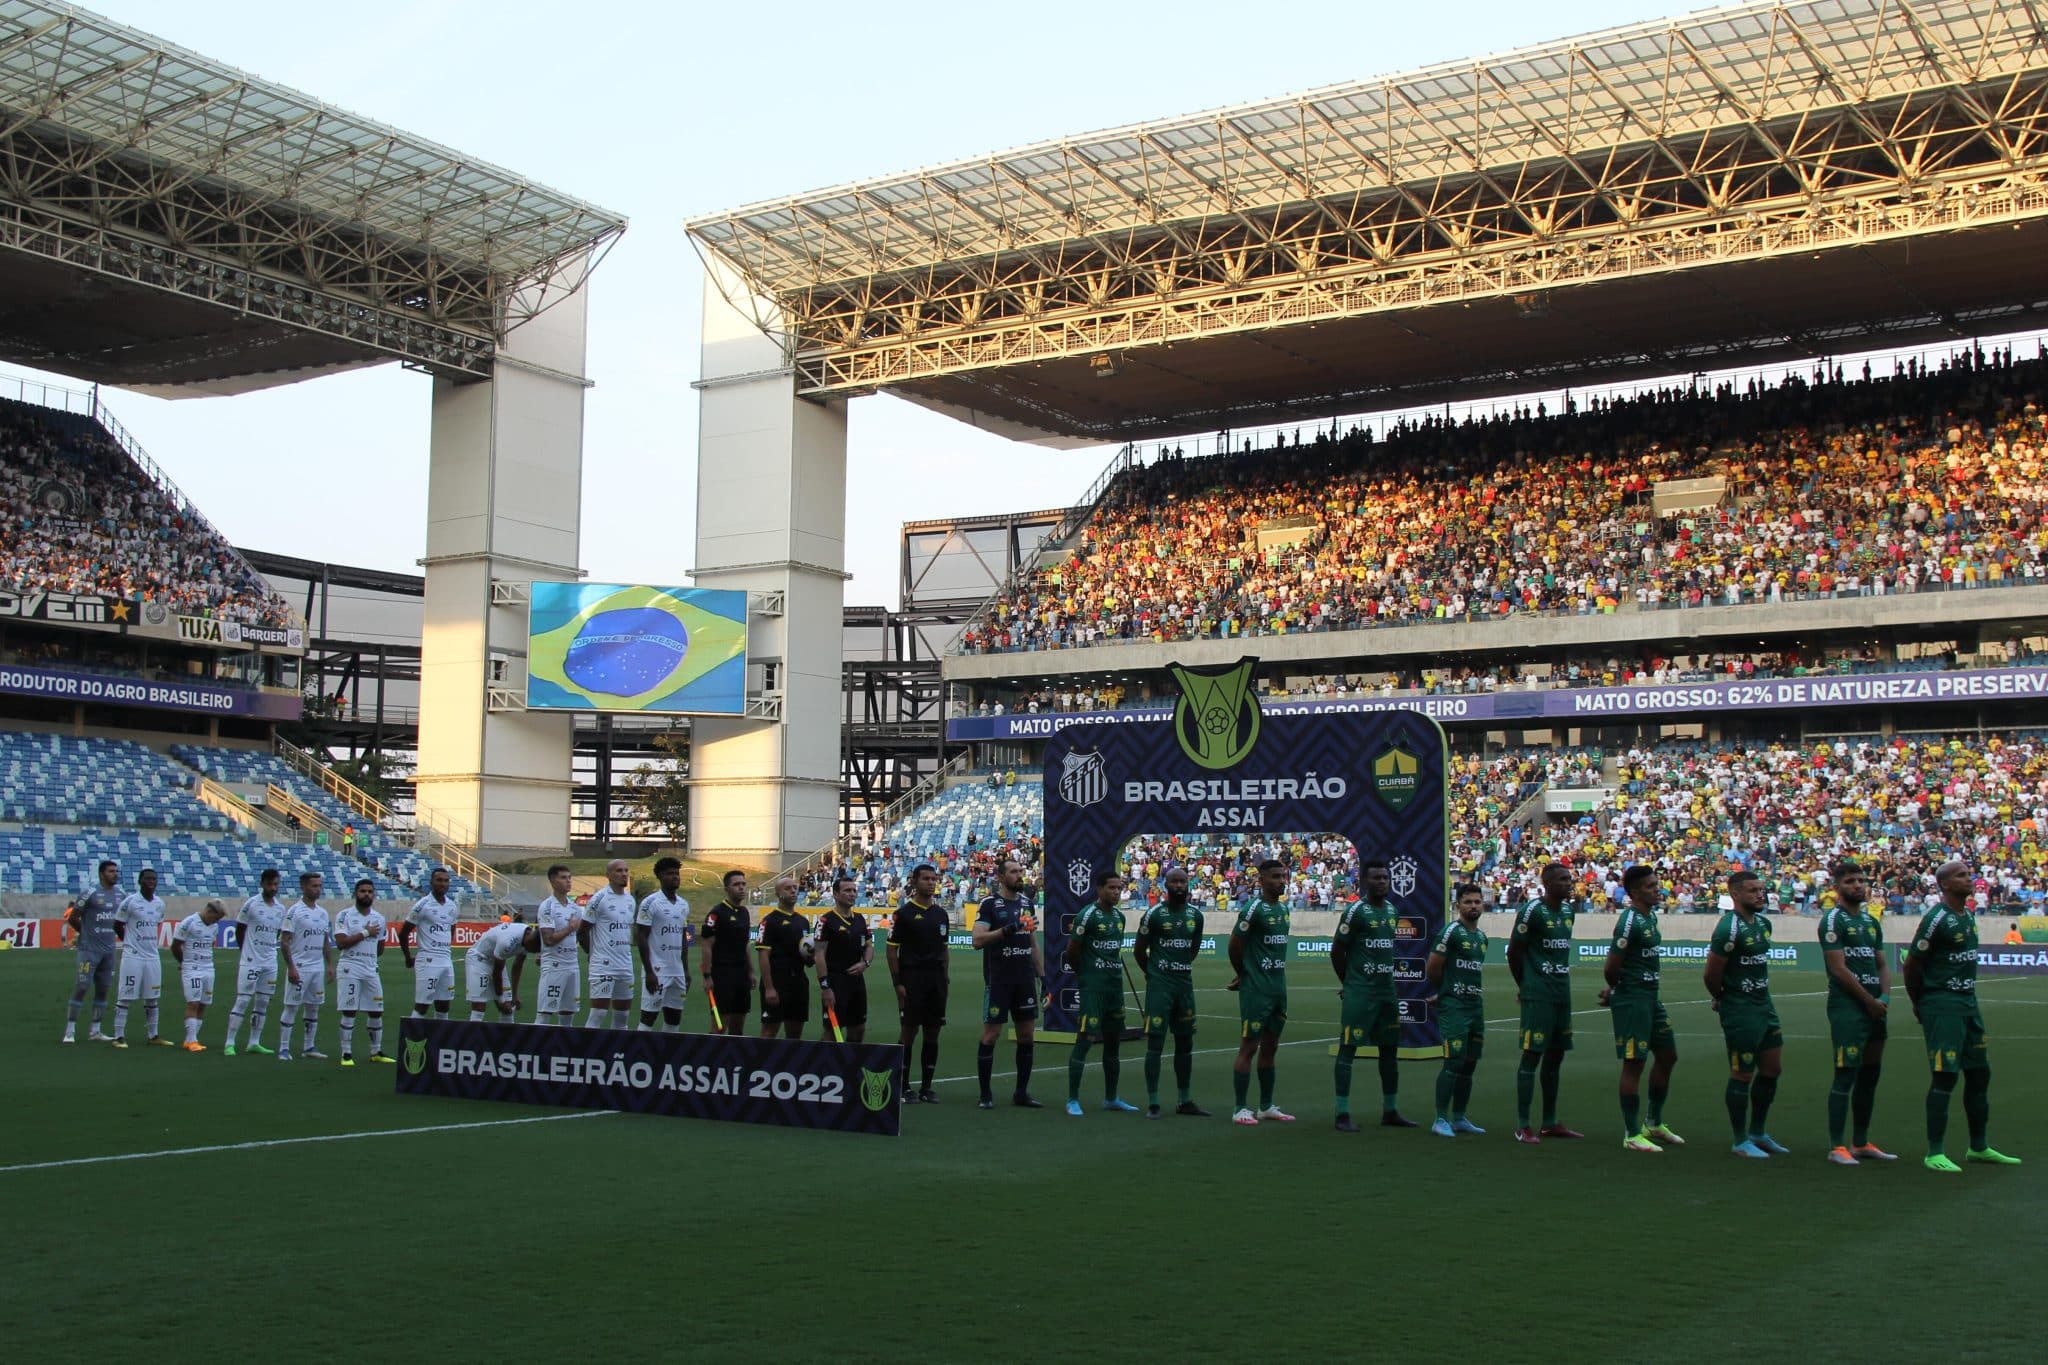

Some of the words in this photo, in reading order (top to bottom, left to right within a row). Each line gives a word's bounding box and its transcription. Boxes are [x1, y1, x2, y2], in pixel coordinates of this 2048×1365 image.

[179, 618, 222, 642] TUSA
[242, 627, 287, 643] BARUERI
[0, 671, 77, 693] RODUTOR
[80, 681, 103, 696] DO
[104, 683, 146, 700] AGRO
[149, 687, 233, 709] BRASILEIRO
[1575, 693, 1631, 711] MATO
[1635, 688, 1723, 709] GROSSO:
[1728, 685, 1773, 704] 62%
[1778, 684, 1807, 702] DE
[1811, 678, 1933, 701] NATUREZA
[1937, 673, 2048, 696] PRESERV
[1010, 719, 1051, 734] MATO
[1125, 771, 1347, 802] BRASILEIRÃO
[1378, 775, 1415, 786] CUIABÁ
[1197, 806, 1267, 827] ASSAÍ
[456, 927, 484, 943] Bitc
[547, 985, 561, 998] 25
[437, 1047, 652, 1088] BRASILEIRÃO
[658, 1064, 741, 1096] ASSAÍ
[749, 1070, 844, 1103] 2022
